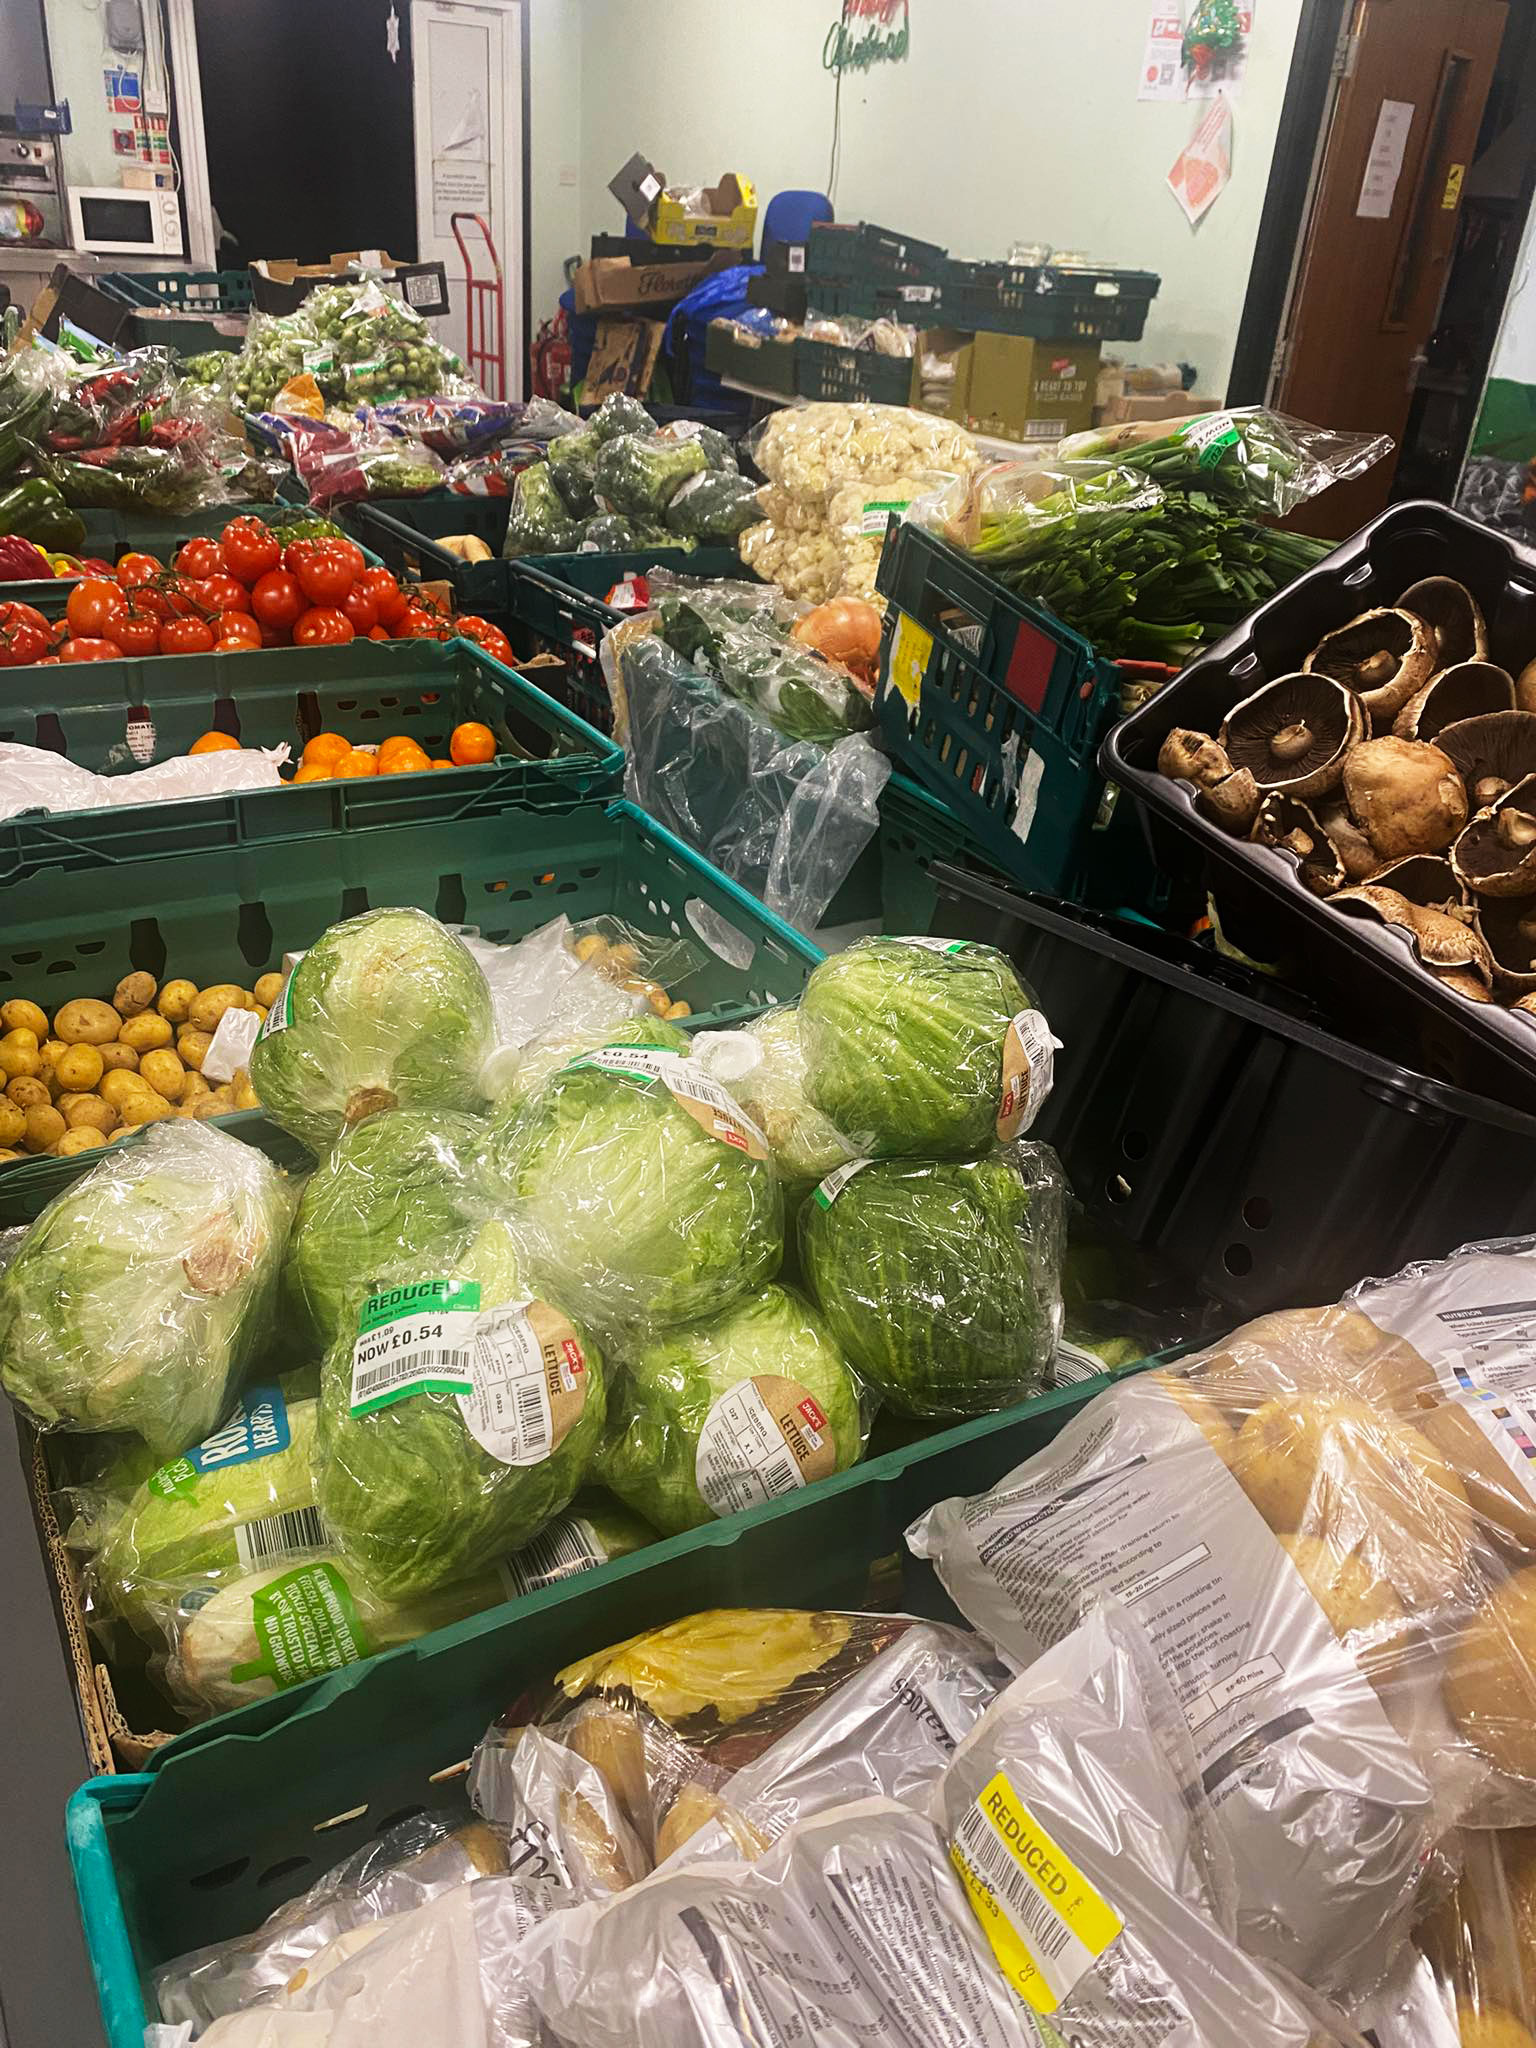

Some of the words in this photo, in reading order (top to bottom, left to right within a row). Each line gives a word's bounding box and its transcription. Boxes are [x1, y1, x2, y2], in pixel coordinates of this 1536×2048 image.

[357, 1342, 389, 1365] NOW
[392, 1325, 443, 1350] £0.54
[543, 1343, 563, 1397] LETTUCE
[251, 1403, 280, 1450] HEARTS
[779, 1413, 811, 1461] LETTUCE
[982, 1531, 1013, 1559] COOKING
[1117, 1544, 1154, 1571] according
[1142, 1574, 1159, 1587] mins
[1180, 1581, 1213, 1605] roasting
[284, 1582, 308, 1615] PICKED
[297, 1612, 323, 1668] SPECIALLY
[309, 1605, 337, 1651] QUALITY
[321, 1591, 345, 1625] PROUD
[334, 1622, 350, 1639] TO
[1165, 1617, 1187, 1634] sized
[1210, 1592, 1227, 1606] and
[1199, 1615, 1223, 1633] shake
[280, 1614, 305, 1664] TRUSTED
[1190, 1648, 1206, 1661] the
[1218, 1619, 1252, 1644] roasting
[1209, 1649, 1239, 1671] turning
[1246, 1667, 1264, 1681] mins
[988, 1791, 1067, 1896] REDUCED
